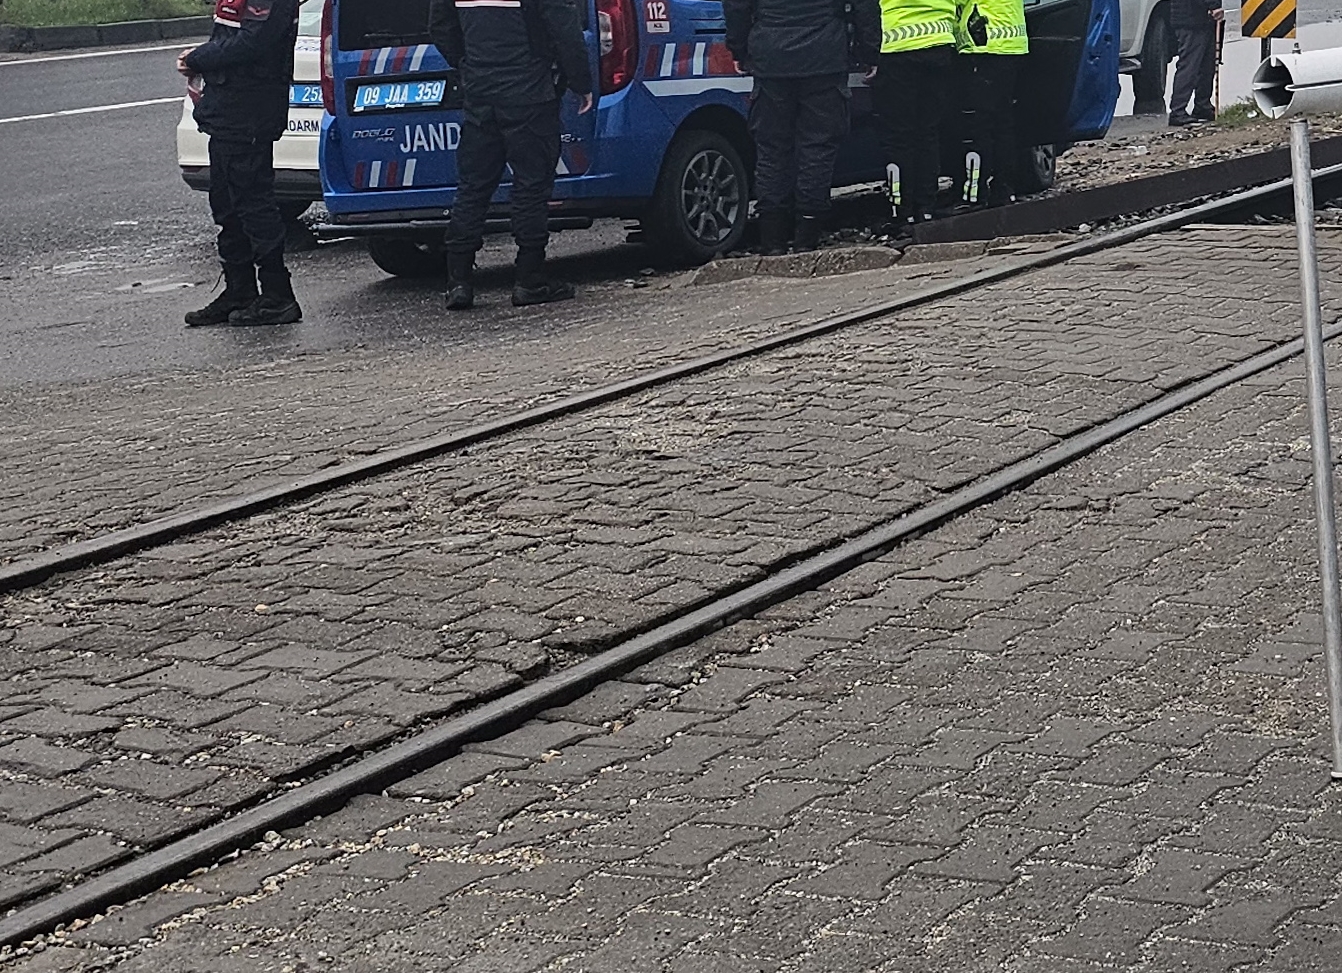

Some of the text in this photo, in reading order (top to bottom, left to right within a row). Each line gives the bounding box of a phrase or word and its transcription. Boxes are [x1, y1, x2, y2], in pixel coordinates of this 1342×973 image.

[646, 1, 667, 19] 112
[363, 82, 441, 105] 09 JAA 359
[288, 120, 319, 132] DARM
[400, 122, 462, 153] JAND
